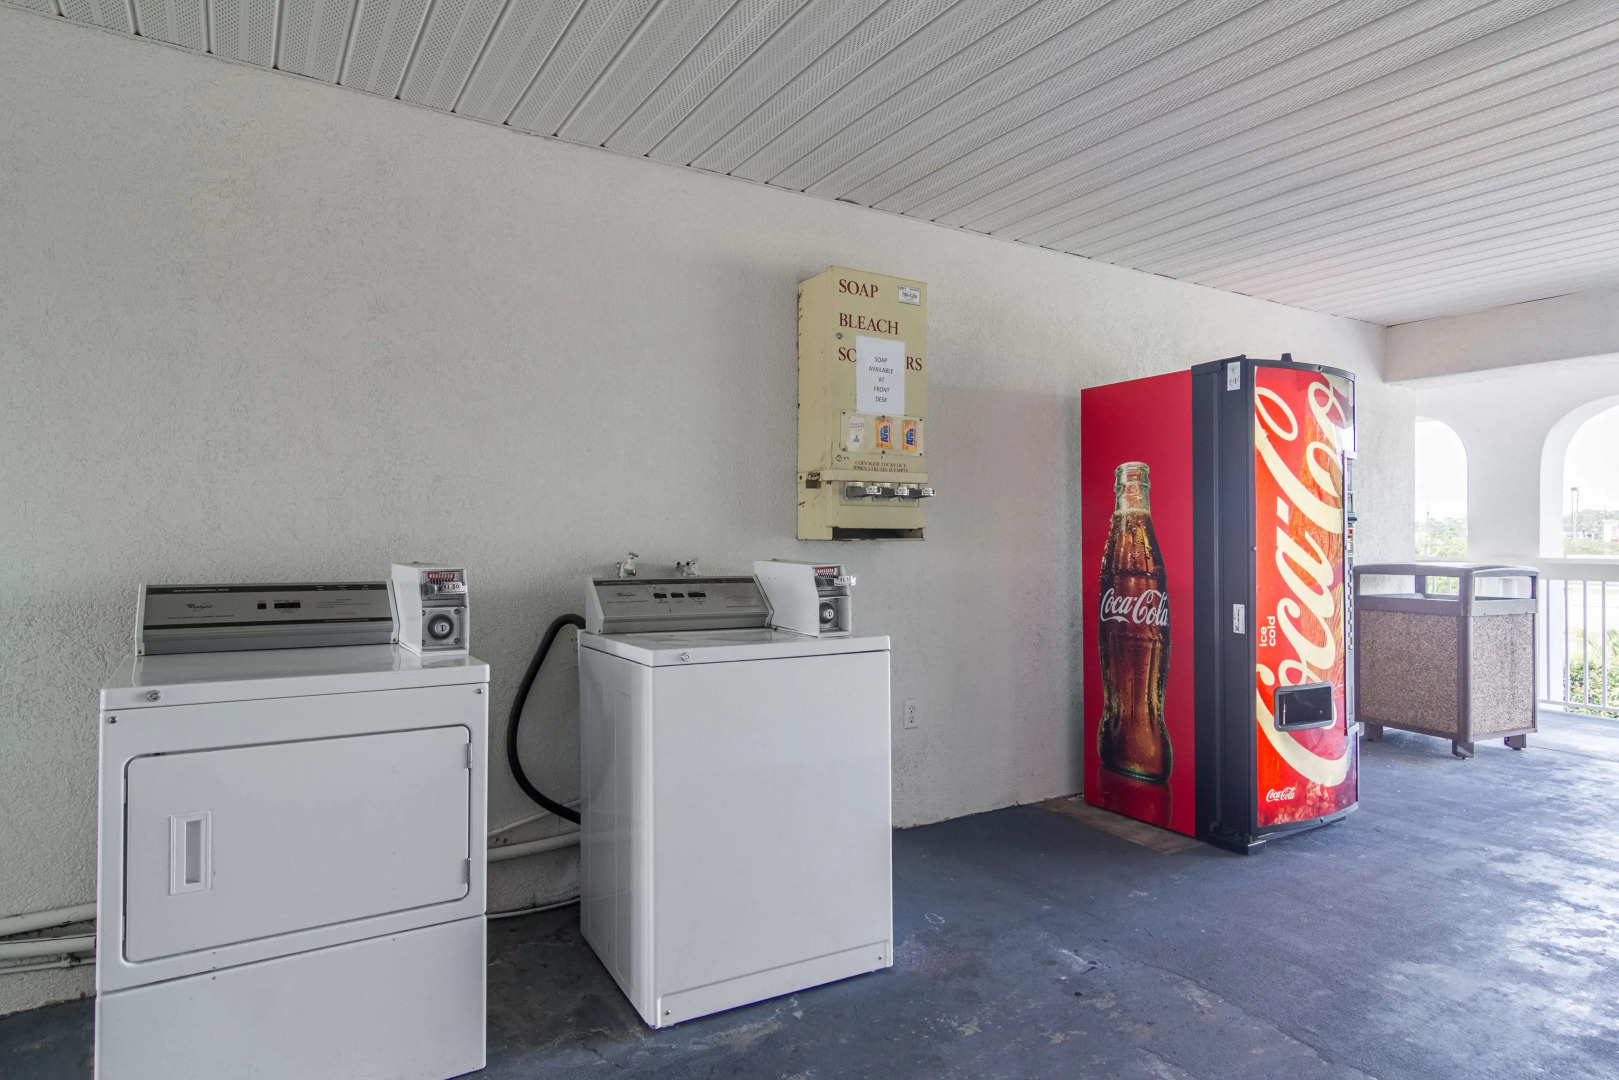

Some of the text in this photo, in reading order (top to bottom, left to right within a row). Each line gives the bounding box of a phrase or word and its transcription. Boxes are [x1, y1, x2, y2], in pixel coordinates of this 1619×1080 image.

[838, 279, 879, 298] SOAP
[839, 312, 899, 335] BLEACH
[874, 356, 888, 364] SOAP
[868, 365, 894, 375] AVAILABLE
[873, 385, 890, 393] FRONT
[1100, 587, 1168, 627] Coca-Cola
[1266, 615, 1276, 647] cold
[1265, 786, 1296, 803] Coca-Cola
